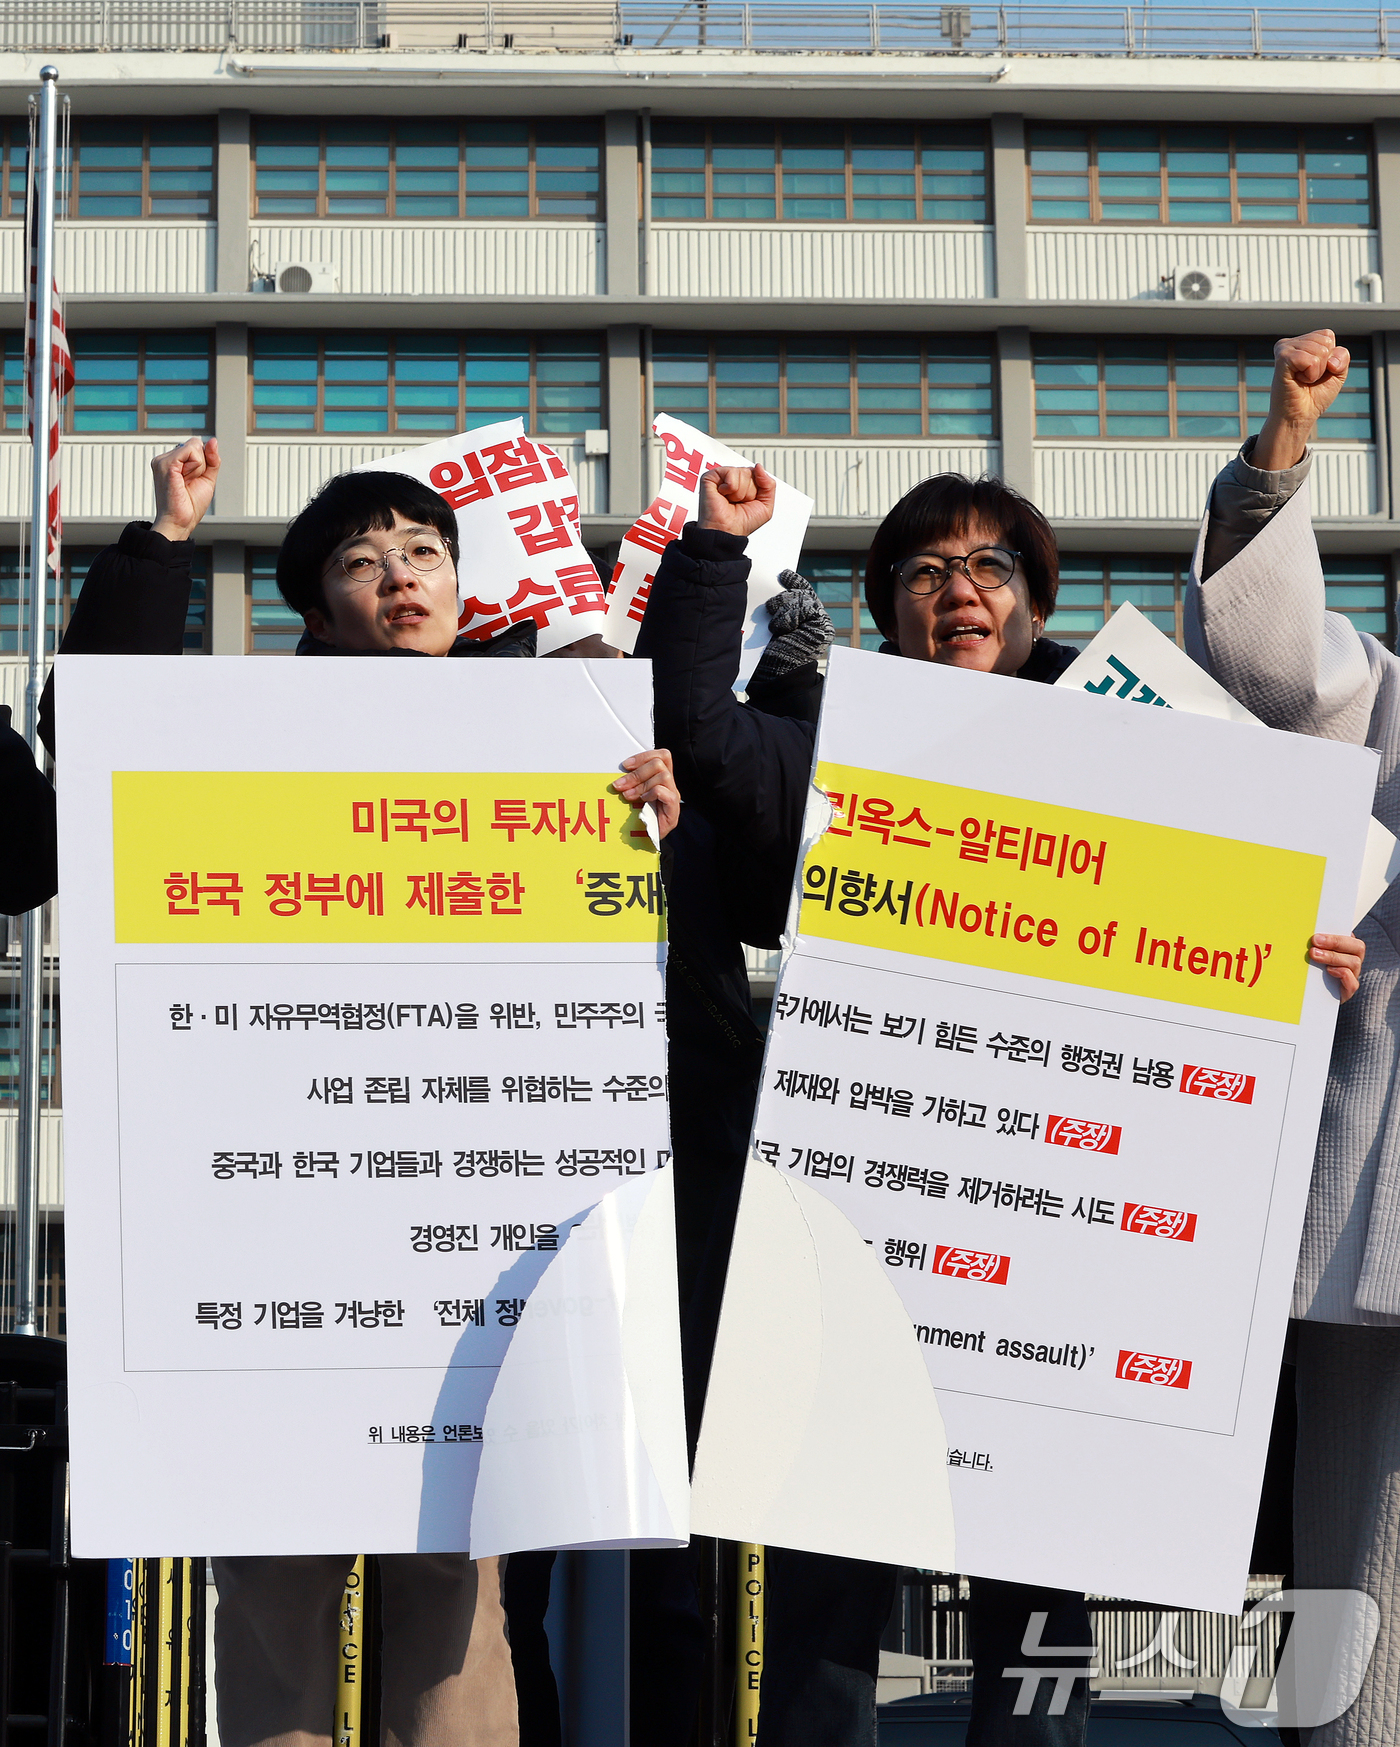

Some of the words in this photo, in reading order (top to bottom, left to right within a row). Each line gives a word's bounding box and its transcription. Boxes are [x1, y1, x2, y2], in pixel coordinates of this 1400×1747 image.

[353, 798, 469, 843] 미국의
[491, 798, 611, 843] 투자사
[164, 871, 244, 916] 한국
[264, 871, 384, 917] 정부에
[406, 871, 526, 916] 제출한
[1078, 920, 1118, 958] of
[248, 1001, 480, 1031] 자유무역협정(FTA)을
[489, 1002, 541, 1030] 위반,
[554, 1001, 645, 1030] 민주주의
[880, 1012, 926, 1046] 보기
[935, 1021, 978, 1054] 힘든
[986, 1031, 1052, 1068] 수준의
[1061, 1044, 1124, 1079] 행정권
[1132, 1056, 1175, 1089] 남용
[1184, 1066, 1247, 1101] (주장)
[306, 1076, 353, 1105] 사업
[363, 1076, 411, 1104] 존립
[421, 1075, 492, 1104] 자체를
[501, 1075, 593, 1103] 위협하는
[602, 1074, 669, 1103] 수준의
[773, 1069, 841, 1106] 제재와
[849, 1081, 915, 1118] 압박을
[921, 1095, 987, 1129] 가하고
[995, 1107, 1040, 1140] 있다
[1049, 1116, 1113, 1151] (주장)
[211, 1151, 283, 1180] 중국과
[292, 1151, 340, 1179] 한국
[349, 1150, 443, 1179] 기업들과
[452, 1149, 546, 1178] 경쟁하는
[554, 1148, 646, 1177] 성공적인
[787, 1147, 855, 1184] 기업의
[863, 1159, 950, 1199] 경쟁력을
[956, 1176, 1065, 1219] 제거하려는
[1070, 1196, 1115, 1225] 시도
[1125, 1203, 1189, 1239] (주장)
[409, 1224, 479, 1253] 경영진
[490, 1223, 560, 1252] 개인을
[884, 1237, 928, 1271] 행위
[937, 1246, 1001, 1282] (주장)
[195, 1301, 242, 1331] 특정
[253, 1300, 325, 1330] 기업을
[334, 1299, 406, 1329] 겨냥한
[913, 1323, 986, 1354] nment
[1121, 1351, 1184, 1386] (주장)
[368, 1425, 383, 1443] 위
[391, 1425, 436, 1443] 내용은
[946, 1447, 994, 1471] 습니다.
[744, 1553, 762, 1690] POLICE
